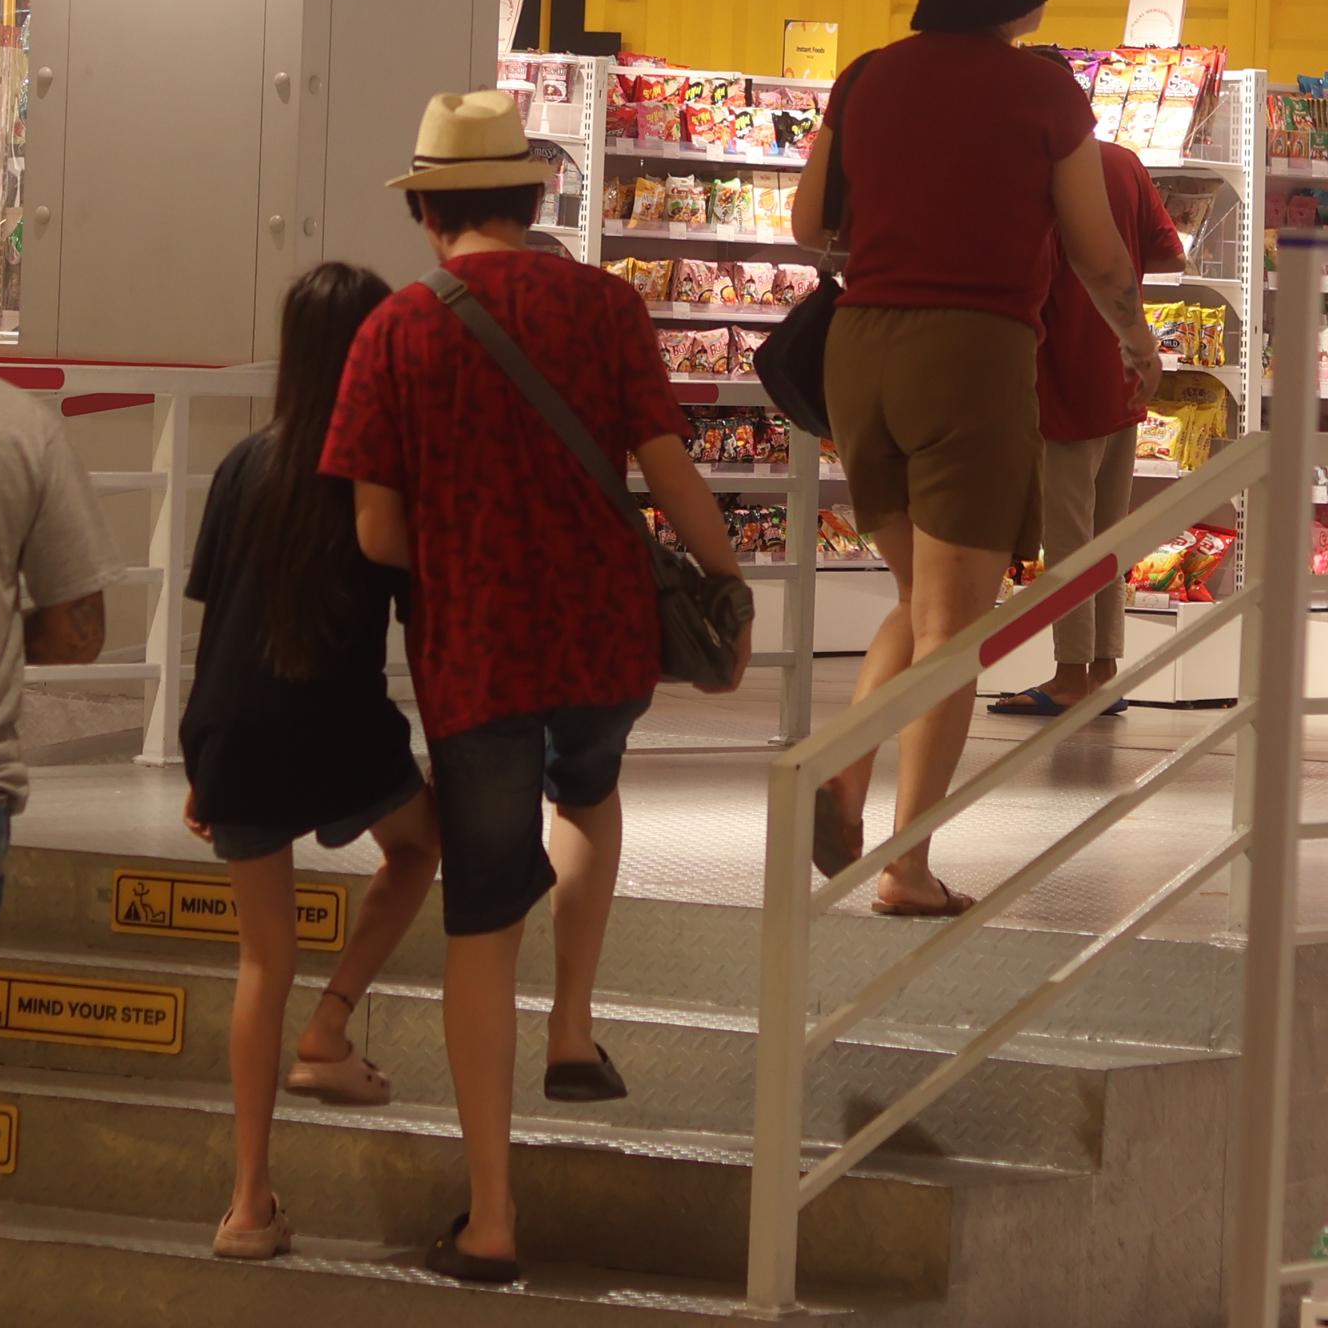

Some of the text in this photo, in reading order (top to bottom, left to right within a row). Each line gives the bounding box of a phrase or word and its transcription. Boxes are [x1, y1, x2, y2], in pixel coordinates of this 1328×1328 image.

[180, 896, 226, 915] MIND
[296, 906, 329, 924] TEP
[17, 996, 167, 1026] MIND YOUR STEP
